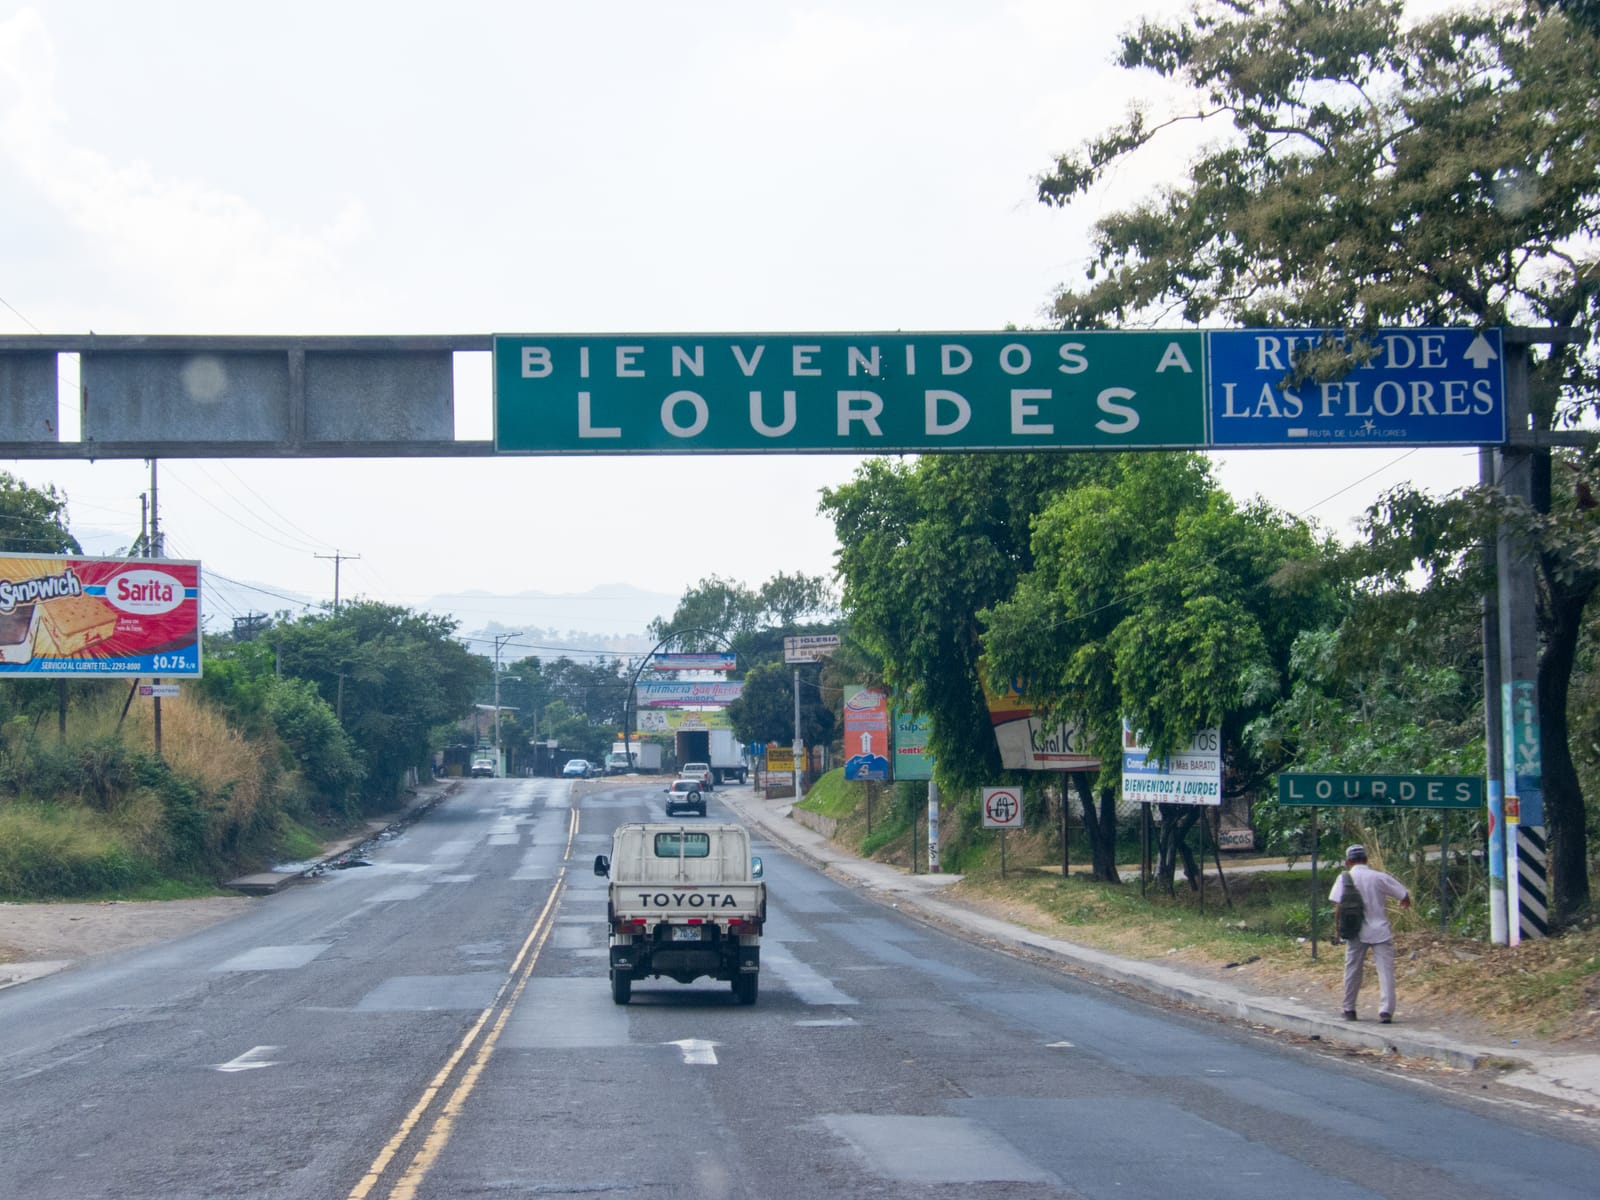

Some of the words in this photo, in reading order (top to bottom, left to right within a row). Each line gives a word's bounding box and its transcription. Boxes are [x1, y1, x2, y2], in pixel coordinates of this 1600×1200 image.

[521, 343, 1088, 378] BIENVENIDOS
[1155, 342, 1193, 373] A
[1383, 335, 1448, 369] DE
[1221, 381, 1303, 418] LAS
[1318, 379, 1493, 417] FLORES
[578, 387, 1140, 438] LOURDES
[1309, 429, 1331, 437] RUTA
[117, 578, 173, 601] Sarita
[153, 654, 185, 670] $0.75
[1125, 778, 1174, 793] BIENVENIDOS
[1176, 780, 1181, 793] A
[1183, 781, 1218, 796] LOURDES
[1289, 780, 1471, 802] LOURDES
[638, 893, 737, 907] TOYOTA
